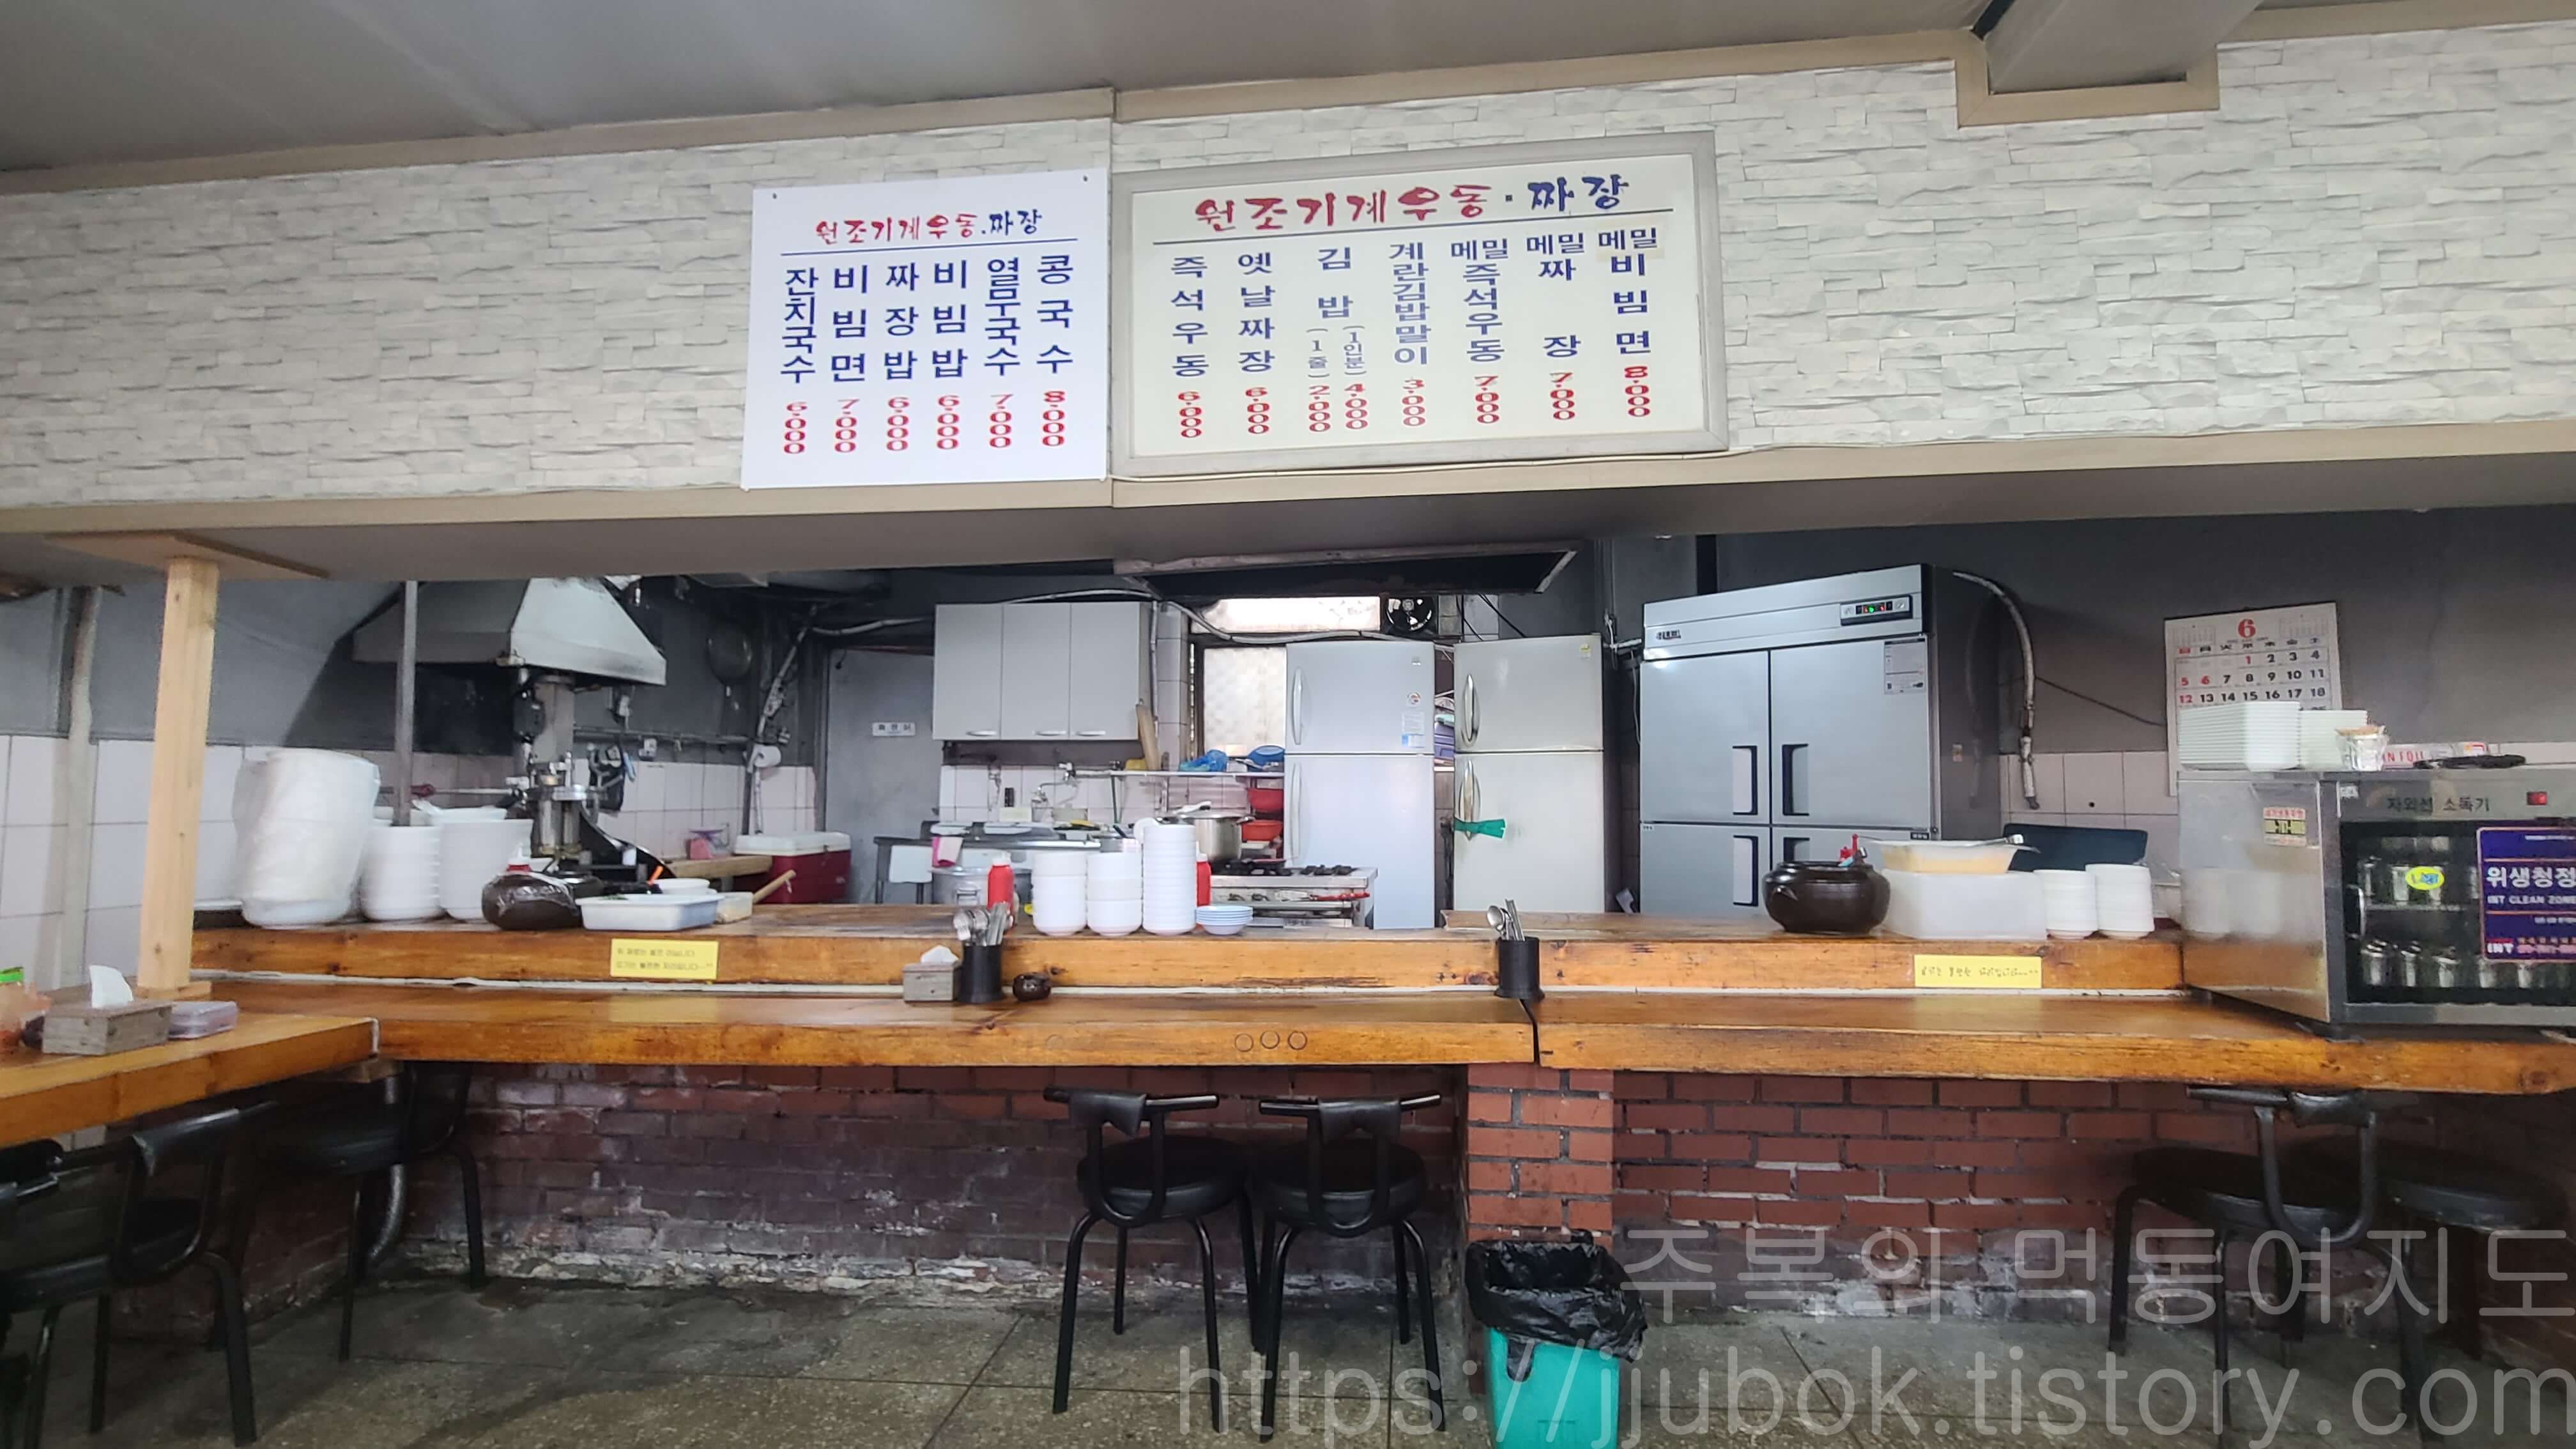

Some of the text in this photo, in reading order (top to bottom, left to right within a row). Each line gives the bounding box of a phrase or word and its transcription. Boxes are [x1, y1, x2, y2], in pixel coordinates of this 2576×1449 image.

[1318, 247, 1354, 318] 김밥
[1451, 238, 1508, 261] 메밀
[1526, 233, 1584, 255] 메밀
[1598, 227, 1657, 250] 메밀
[780, 267, 819, 384] 잔치국수
[831, 264, 868, 382] 비빔면
[884, 262, 920, 380] 짜장밥
[932, 259, 968, 379] 비빔밥
[984, 256, 1021, 376] 열무국수
[1036, 255, 1073, 374] 콩국수
[1171, 256, 1209, 377] 즉석우동
[1238, 252, 1275, 372] 옛날짜장
[1390, 242, 1430, 364] 계란김밥말이
[1463, 263, 1505, 362] 즉석우동
[1538, 258, 1581, 357] 짜장
[1611, 253, 1650, 355] 비빔면
[2181, 670, 2324, 686] 5 6 7 8 9 10 11
[2238, 619, 2256, 638] 6
[2245, 650, 2320, 664] 1 2 3 4
[2179, 687, 2326, 703] 12 13 14 15 16 17 18
[2387, 797, 2490, 813] 자외선 소독기
